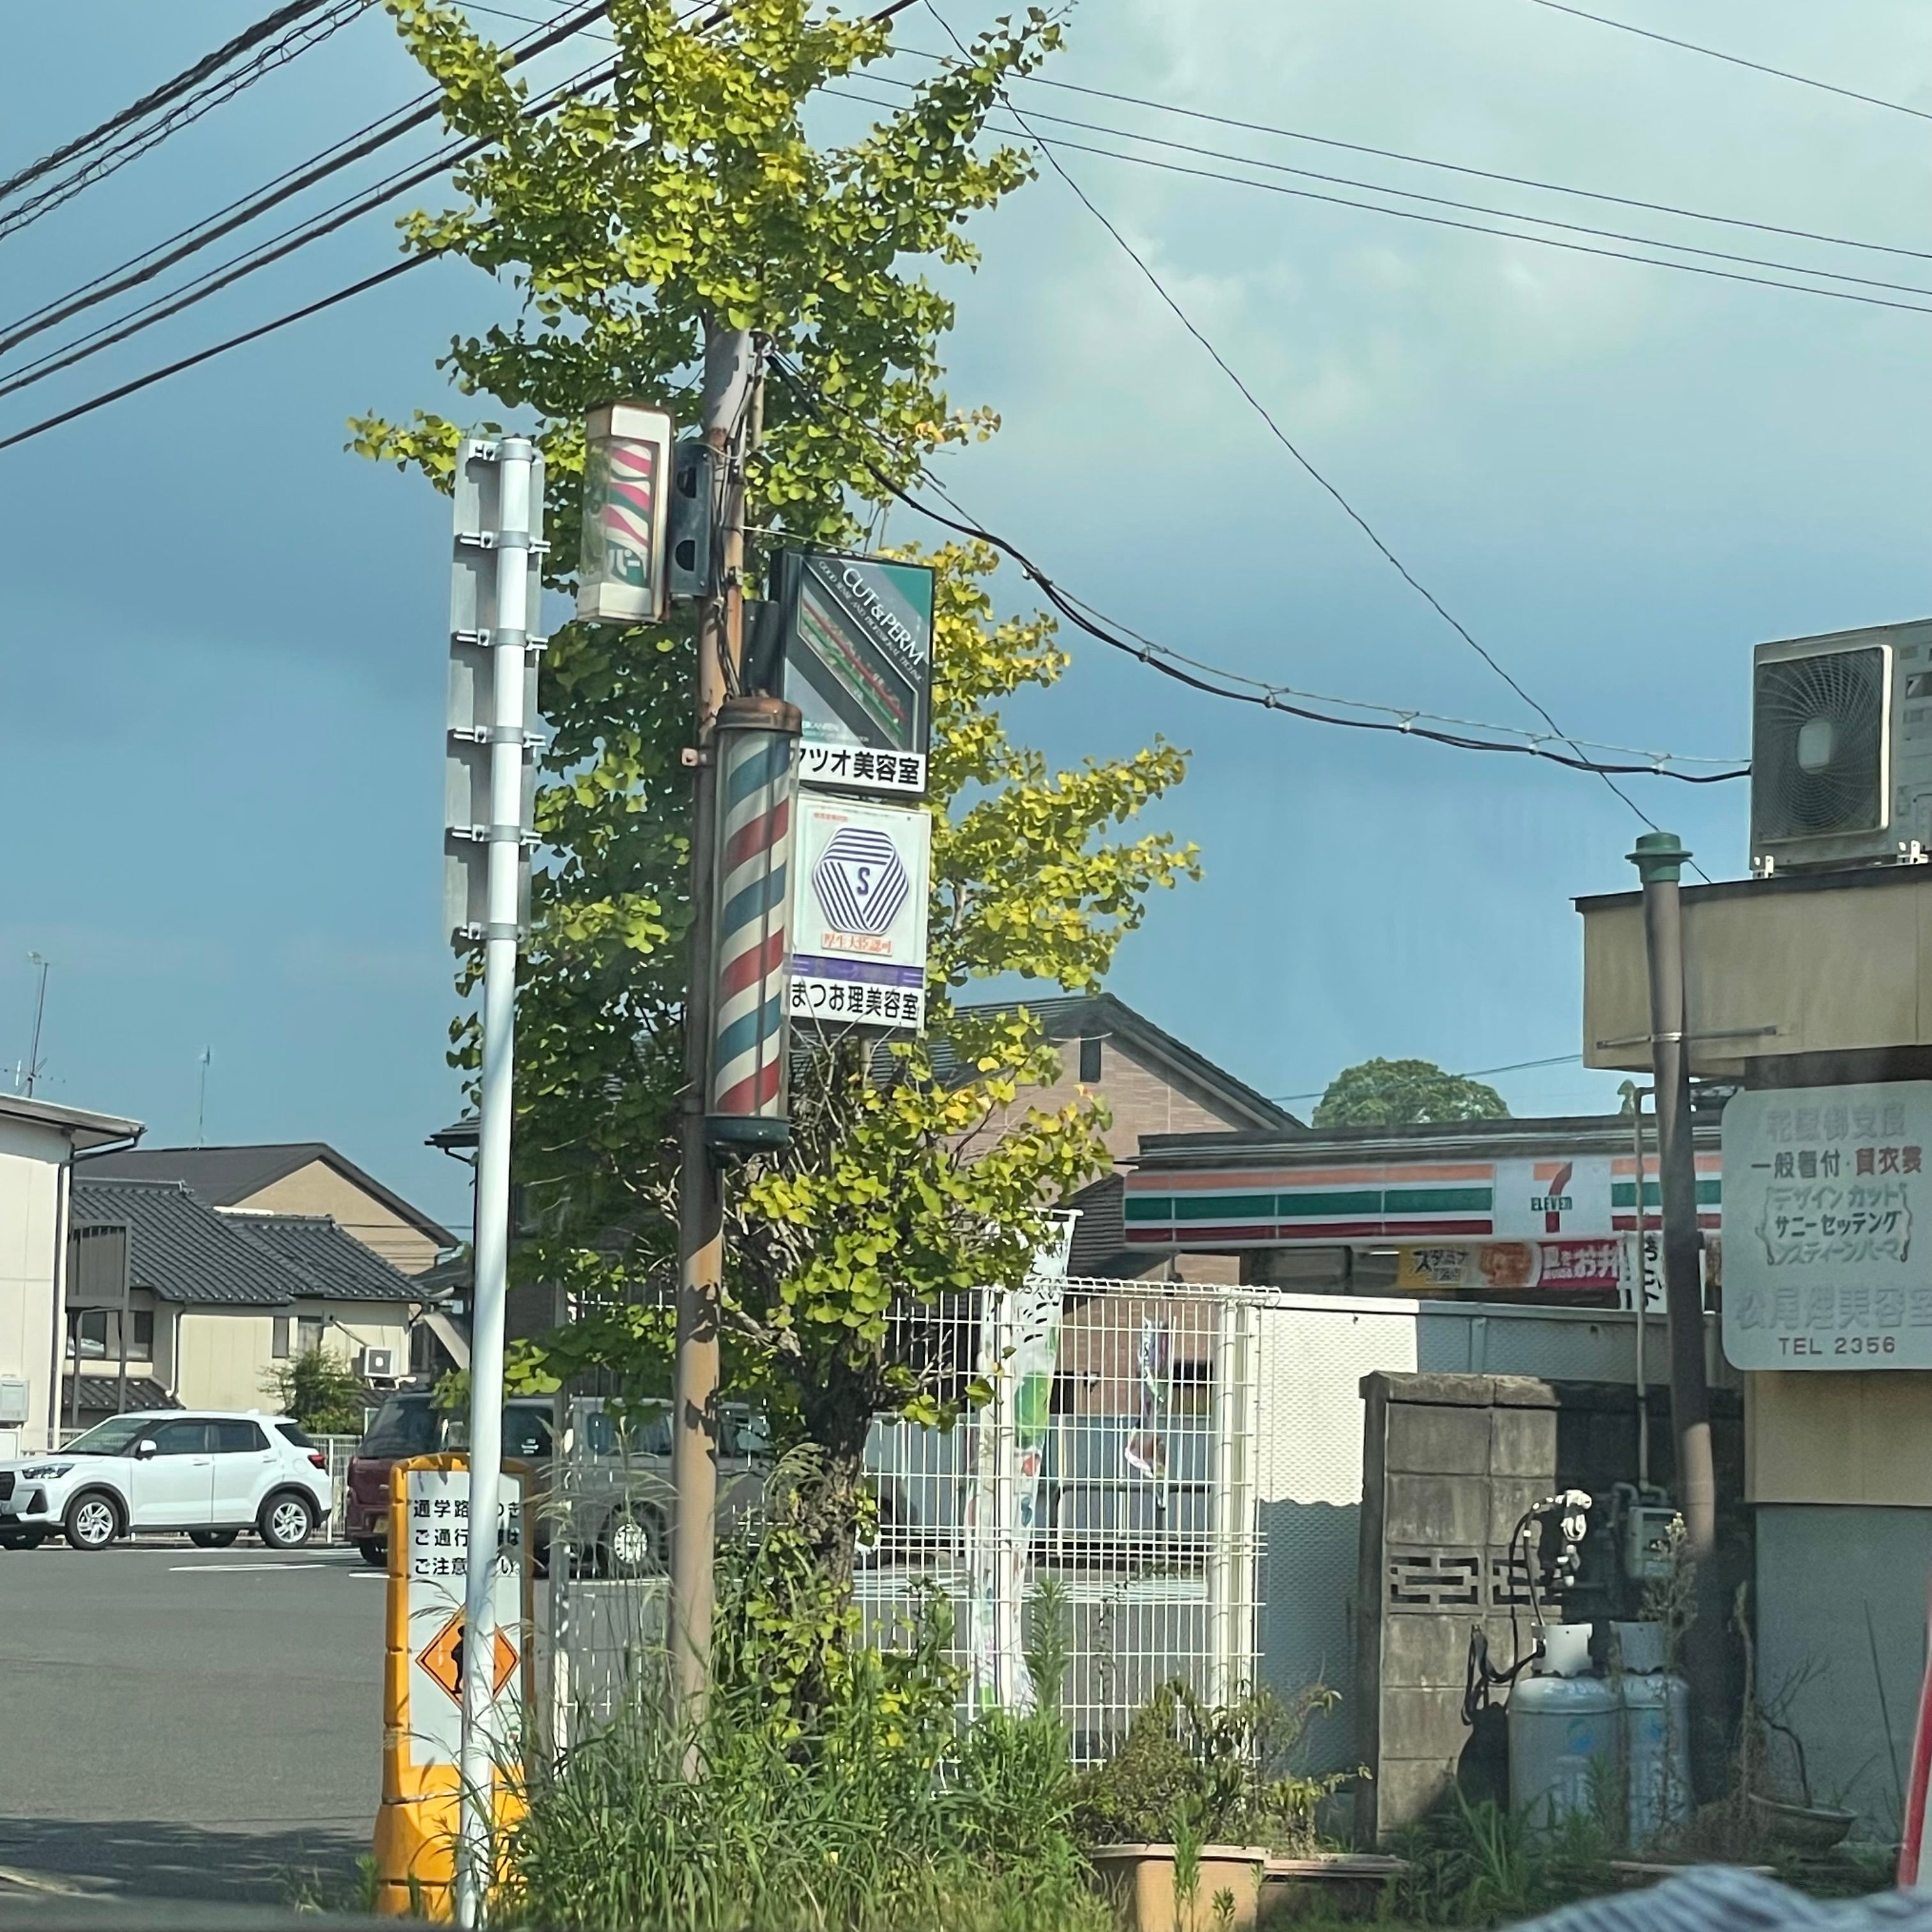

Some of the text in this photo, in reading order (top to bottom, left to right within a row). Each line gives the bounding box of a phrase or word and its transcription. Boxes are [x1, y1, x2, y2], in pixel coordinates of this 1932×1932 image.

[856, 866, 871, 896] S
[792, 983, 919, 1022] まつお理美容室
[1778, 1336, 1896, 1355] TEL 2356
